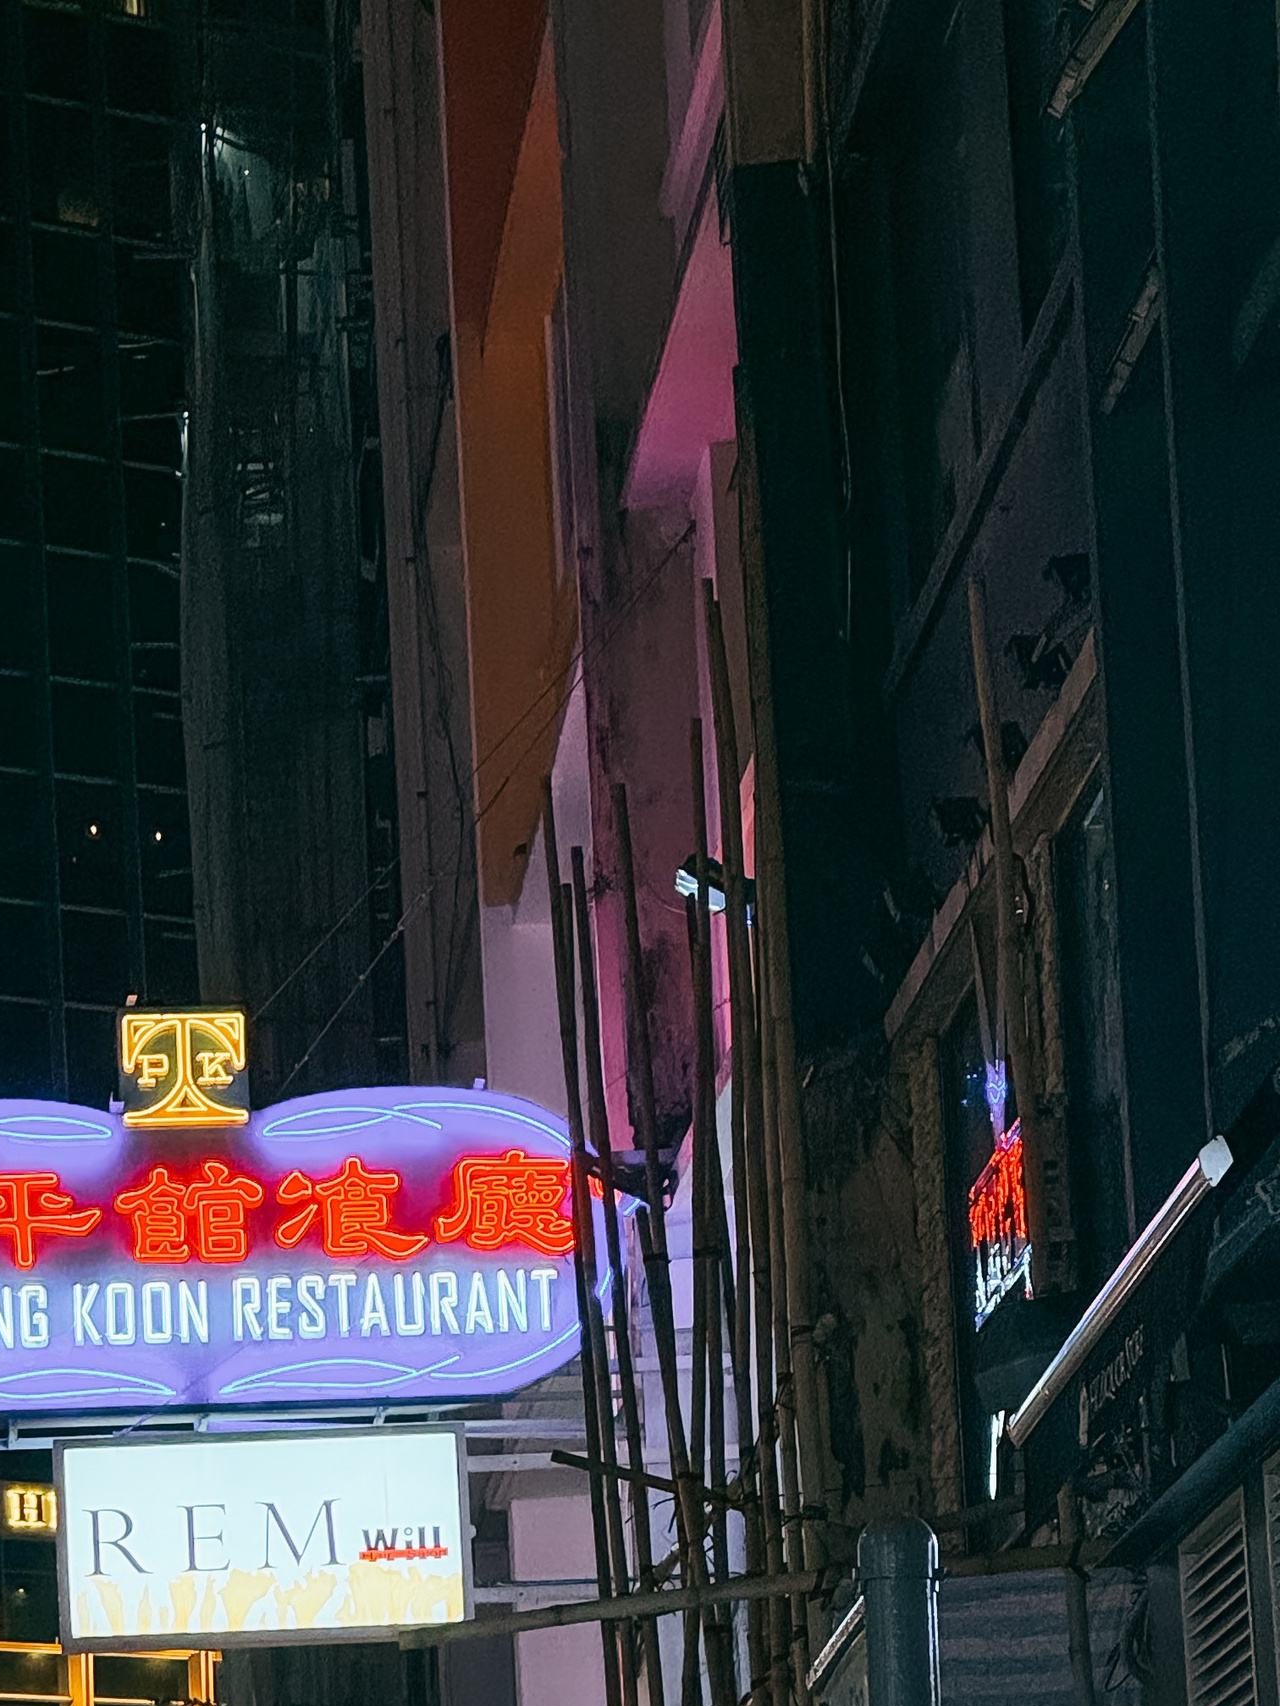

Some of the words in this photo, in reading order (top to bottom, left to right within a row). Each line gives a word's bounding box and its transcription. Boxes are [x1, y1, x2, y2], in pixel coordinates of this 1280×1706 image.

[73, 1279, 209, 1348] KOON
[231, 1267, 559, 1344] RESTAURANT
[81, 1497, 348, 1578] REM
[361, 1525, 442, 1561] Will
